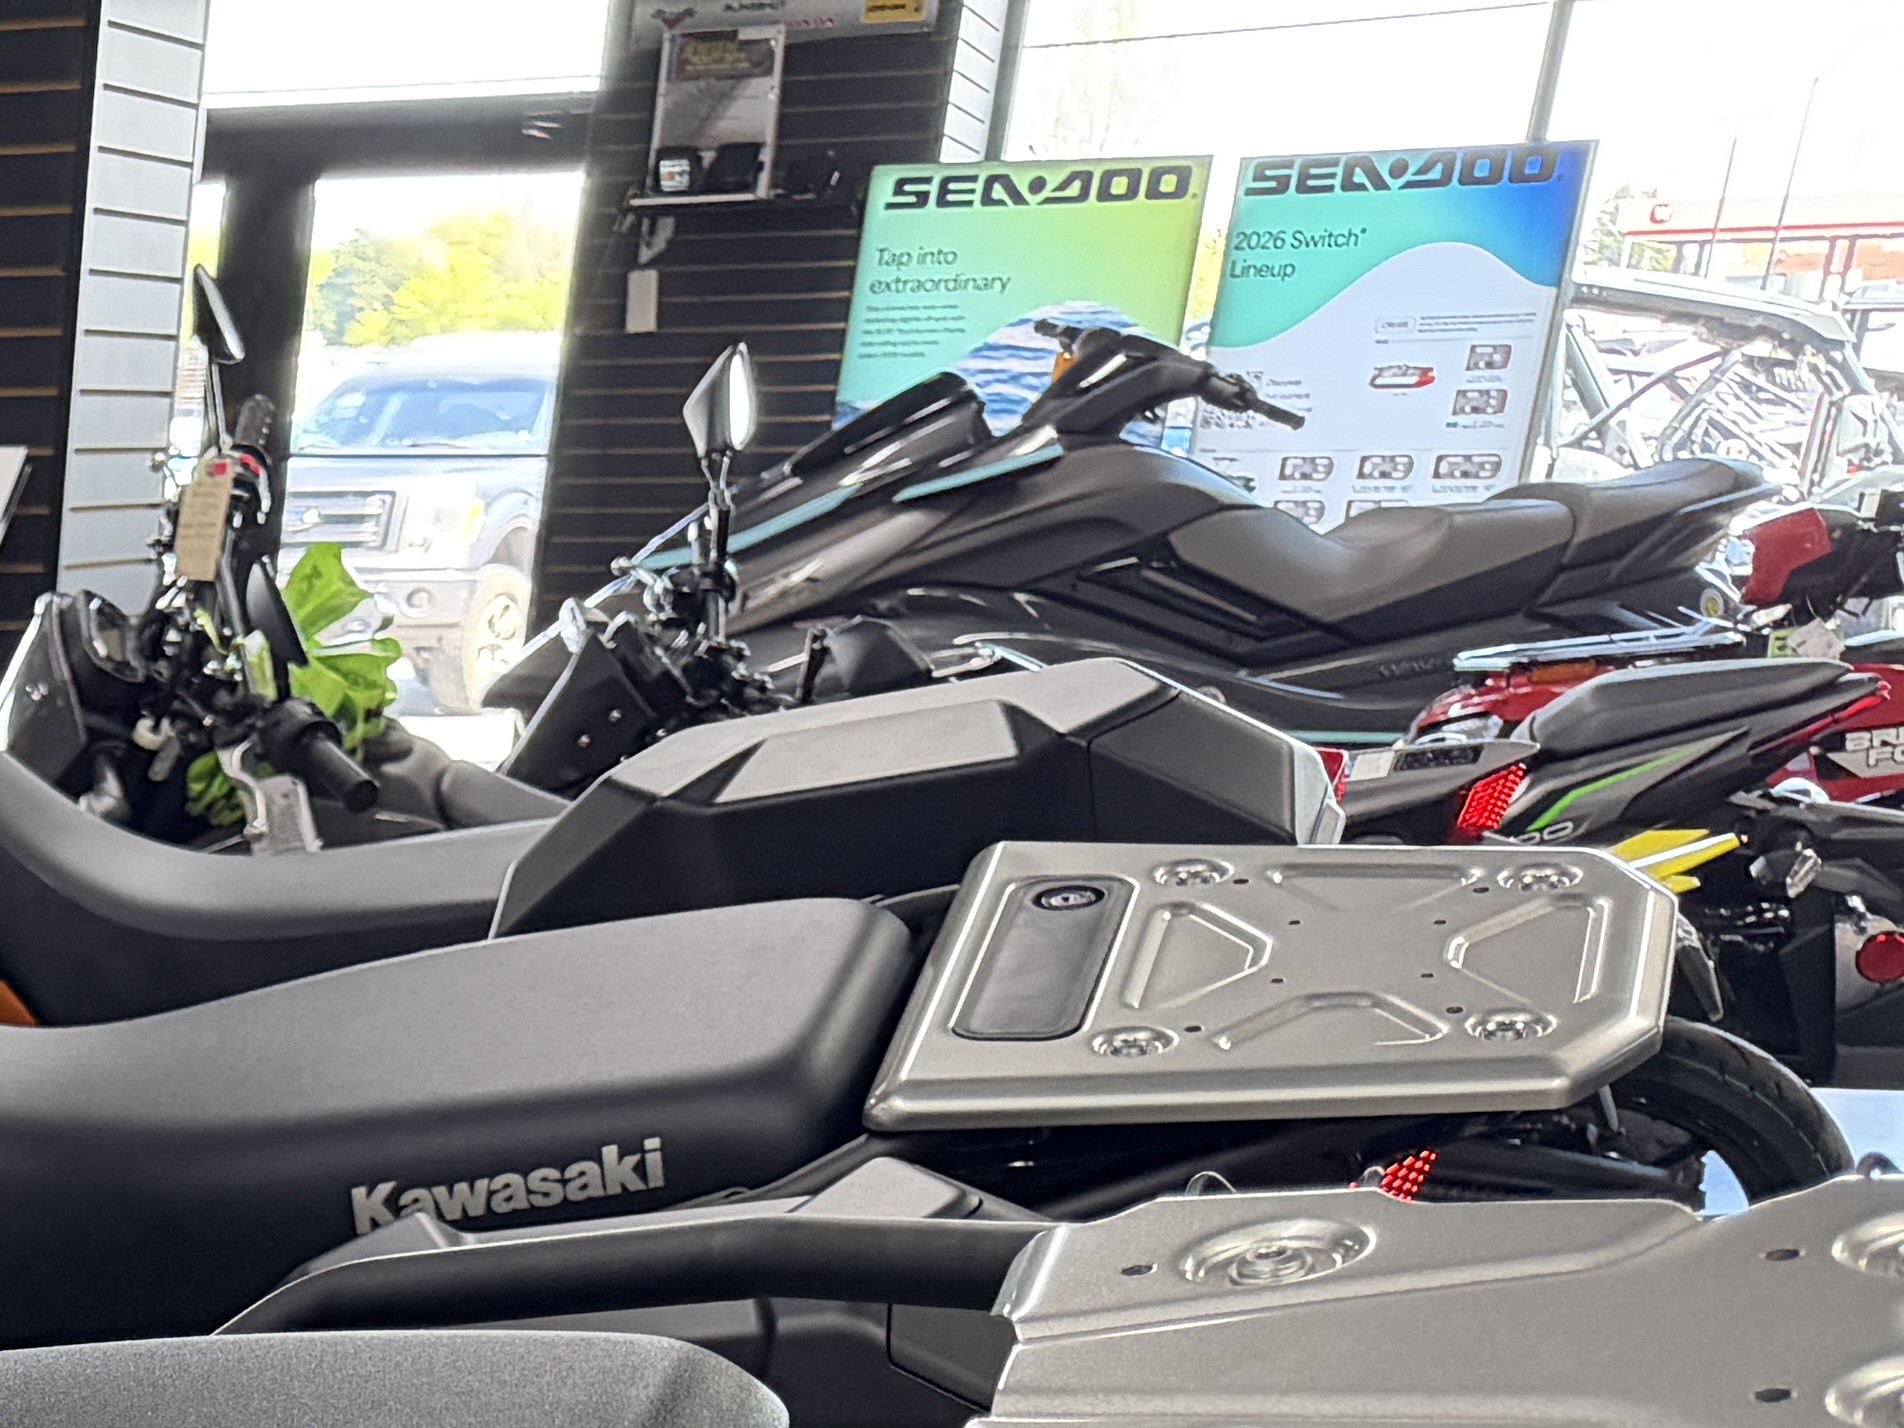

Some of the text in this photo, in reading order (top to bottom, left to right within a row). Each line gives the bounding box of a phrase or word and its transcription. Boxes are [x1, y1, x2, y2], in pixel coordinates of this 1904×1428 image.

[1234, 230, 1286, 250] 2026
[875, 245, 958, 269] Tap into
[1229, 259, 1296, 282] Lineup
[869, 272, 1012, 295] extraordinary
[350, 1137, 666, 1236] Kawasaki
